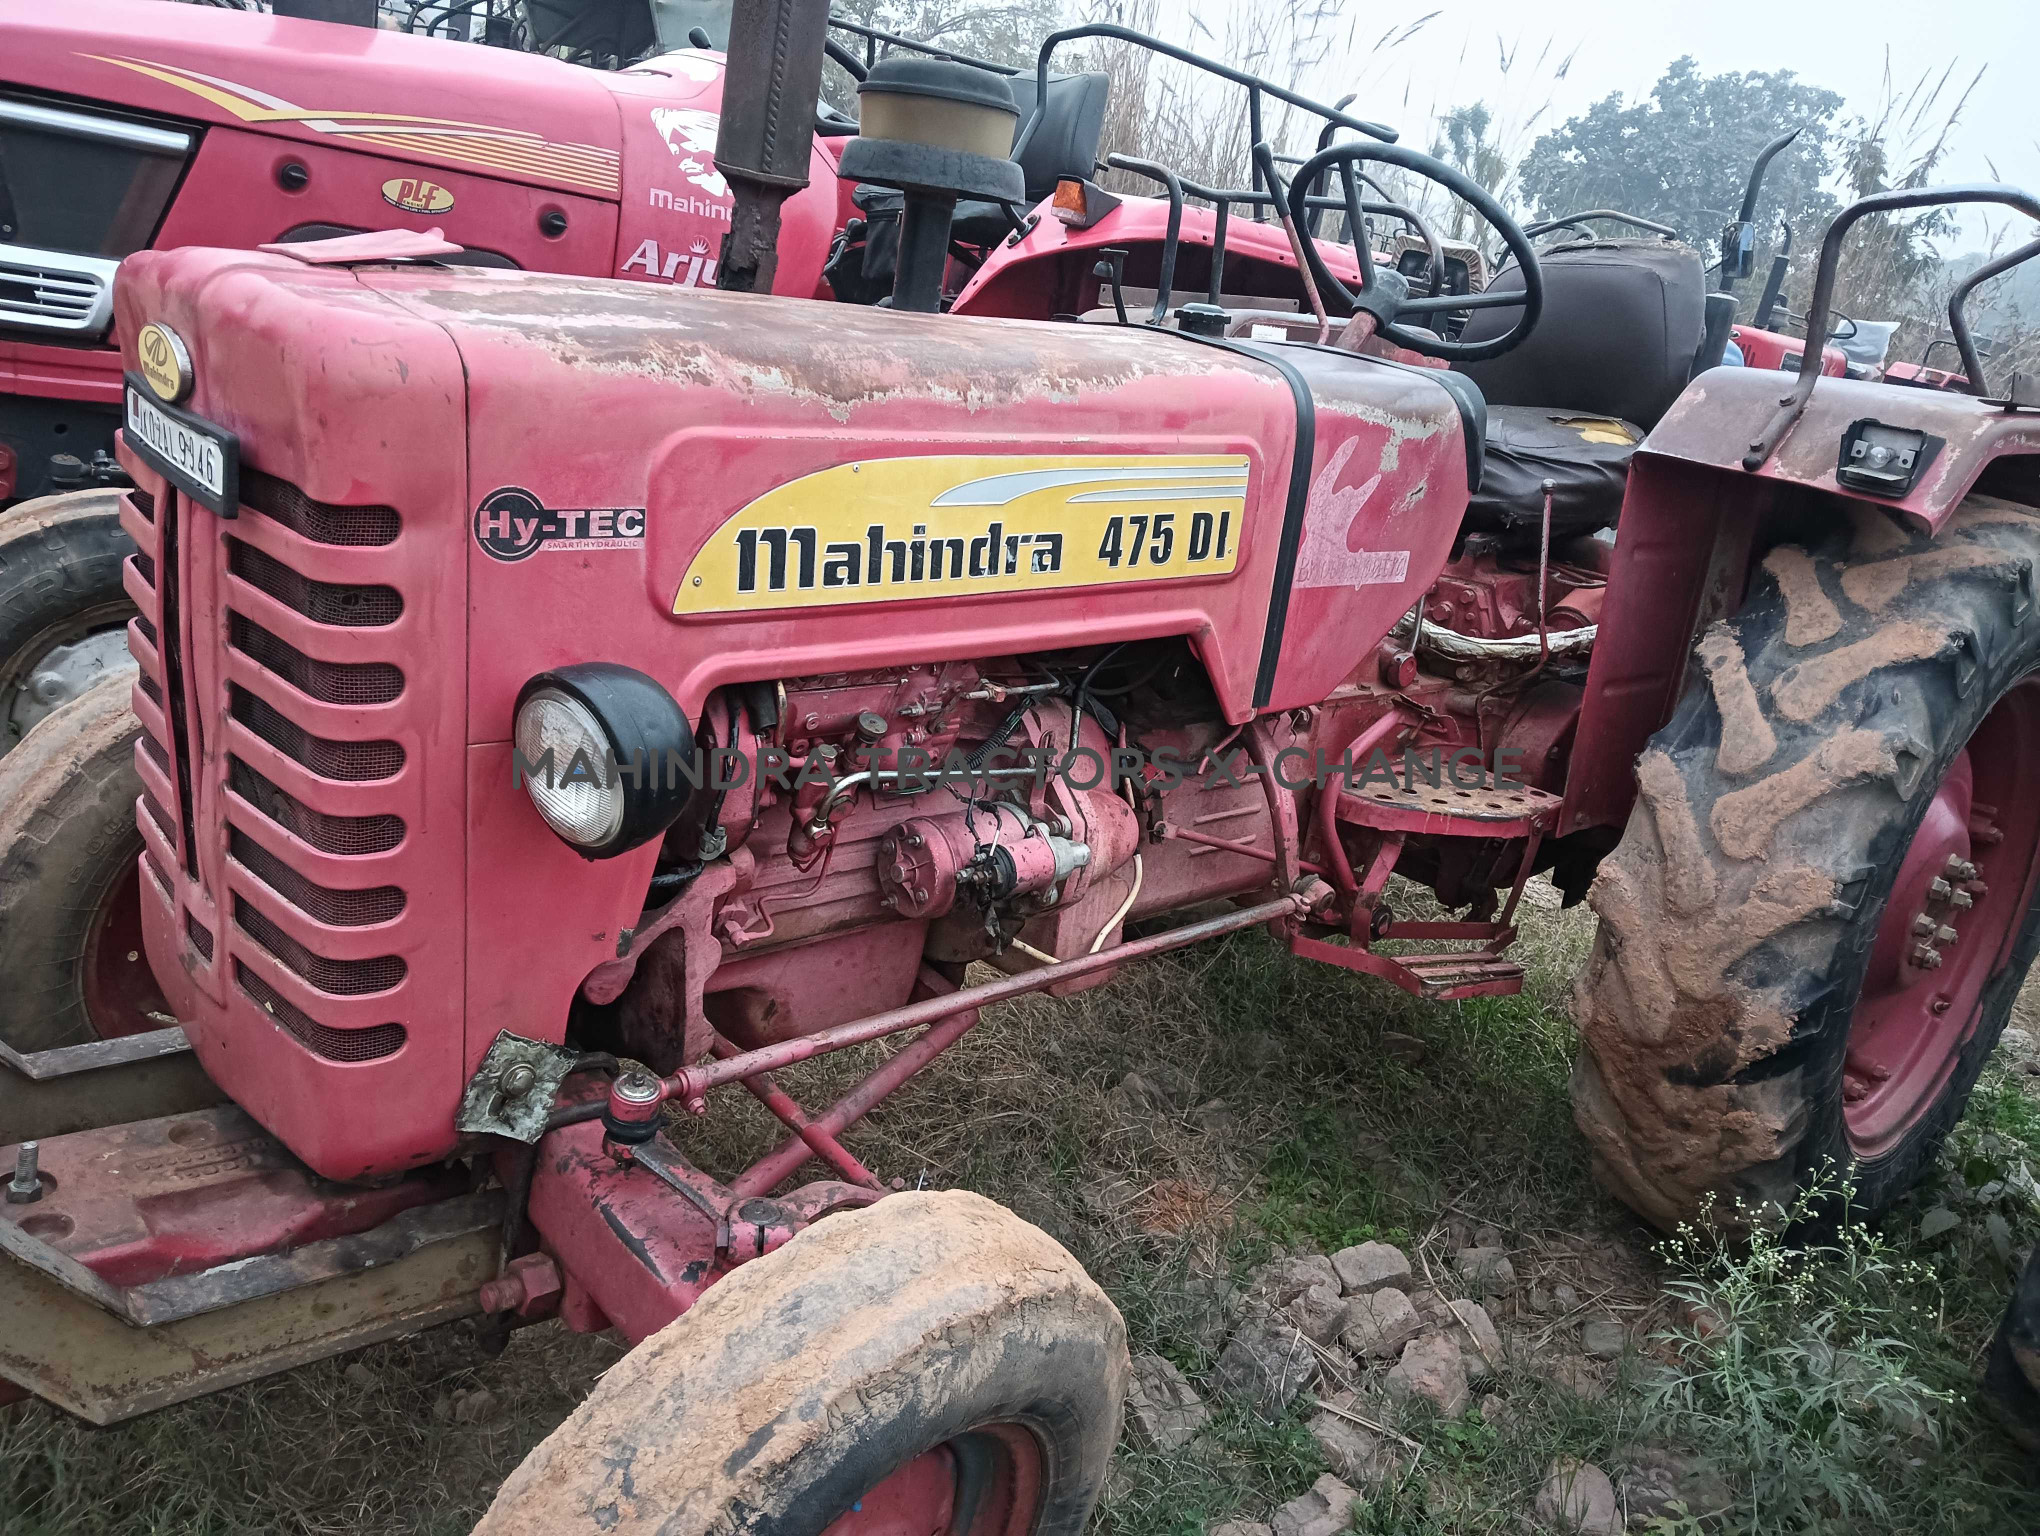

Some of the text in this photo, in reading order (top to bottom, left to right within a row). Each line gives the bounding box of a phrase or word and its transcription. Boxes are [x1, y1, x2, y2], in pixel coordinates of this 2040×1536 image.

[479, 510, 644, 545] Hy-TEC
[547, 540, 638, 549] SMART HYDRAULIC
[733, 510, 1231, 592] Mahindra 475 DI
